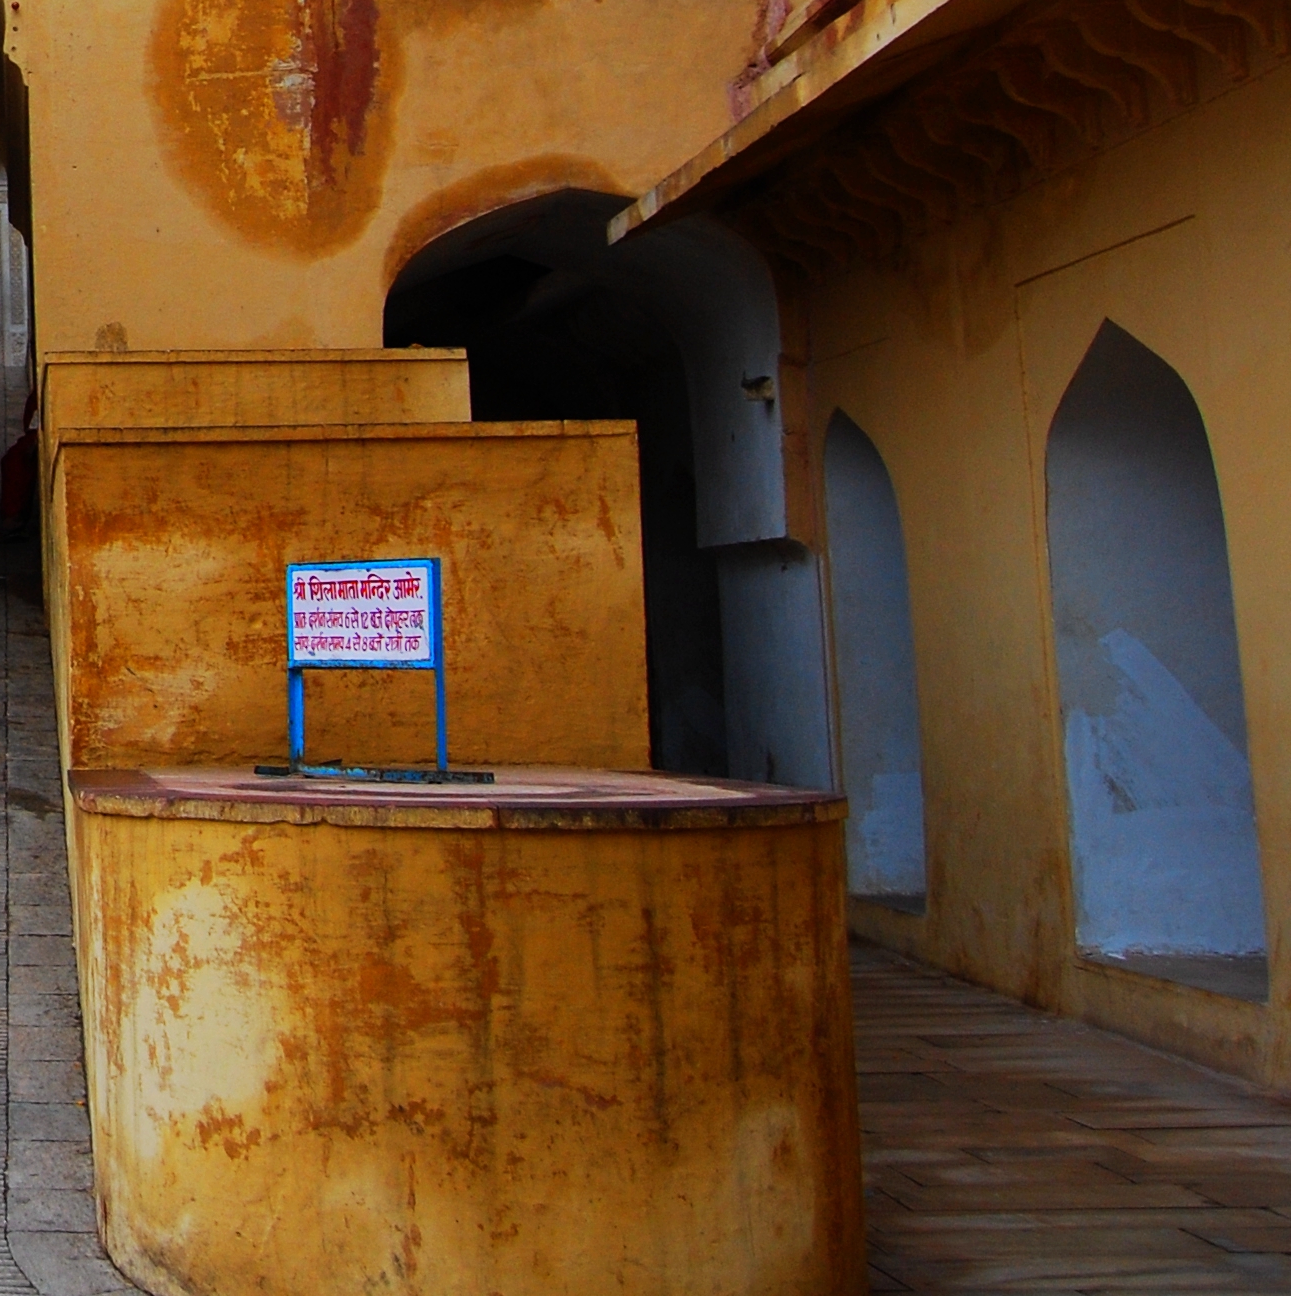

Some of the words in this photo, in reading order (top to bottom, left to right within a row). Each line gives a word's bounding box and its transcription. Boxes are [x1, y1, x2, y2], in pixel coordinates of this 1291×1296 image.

[307, 576, 337, 601] शिला
[338, 580, 359, 600] माता
[360, 574, 391, 600] मन्दिर
[404, 636, 421, 651] तक
